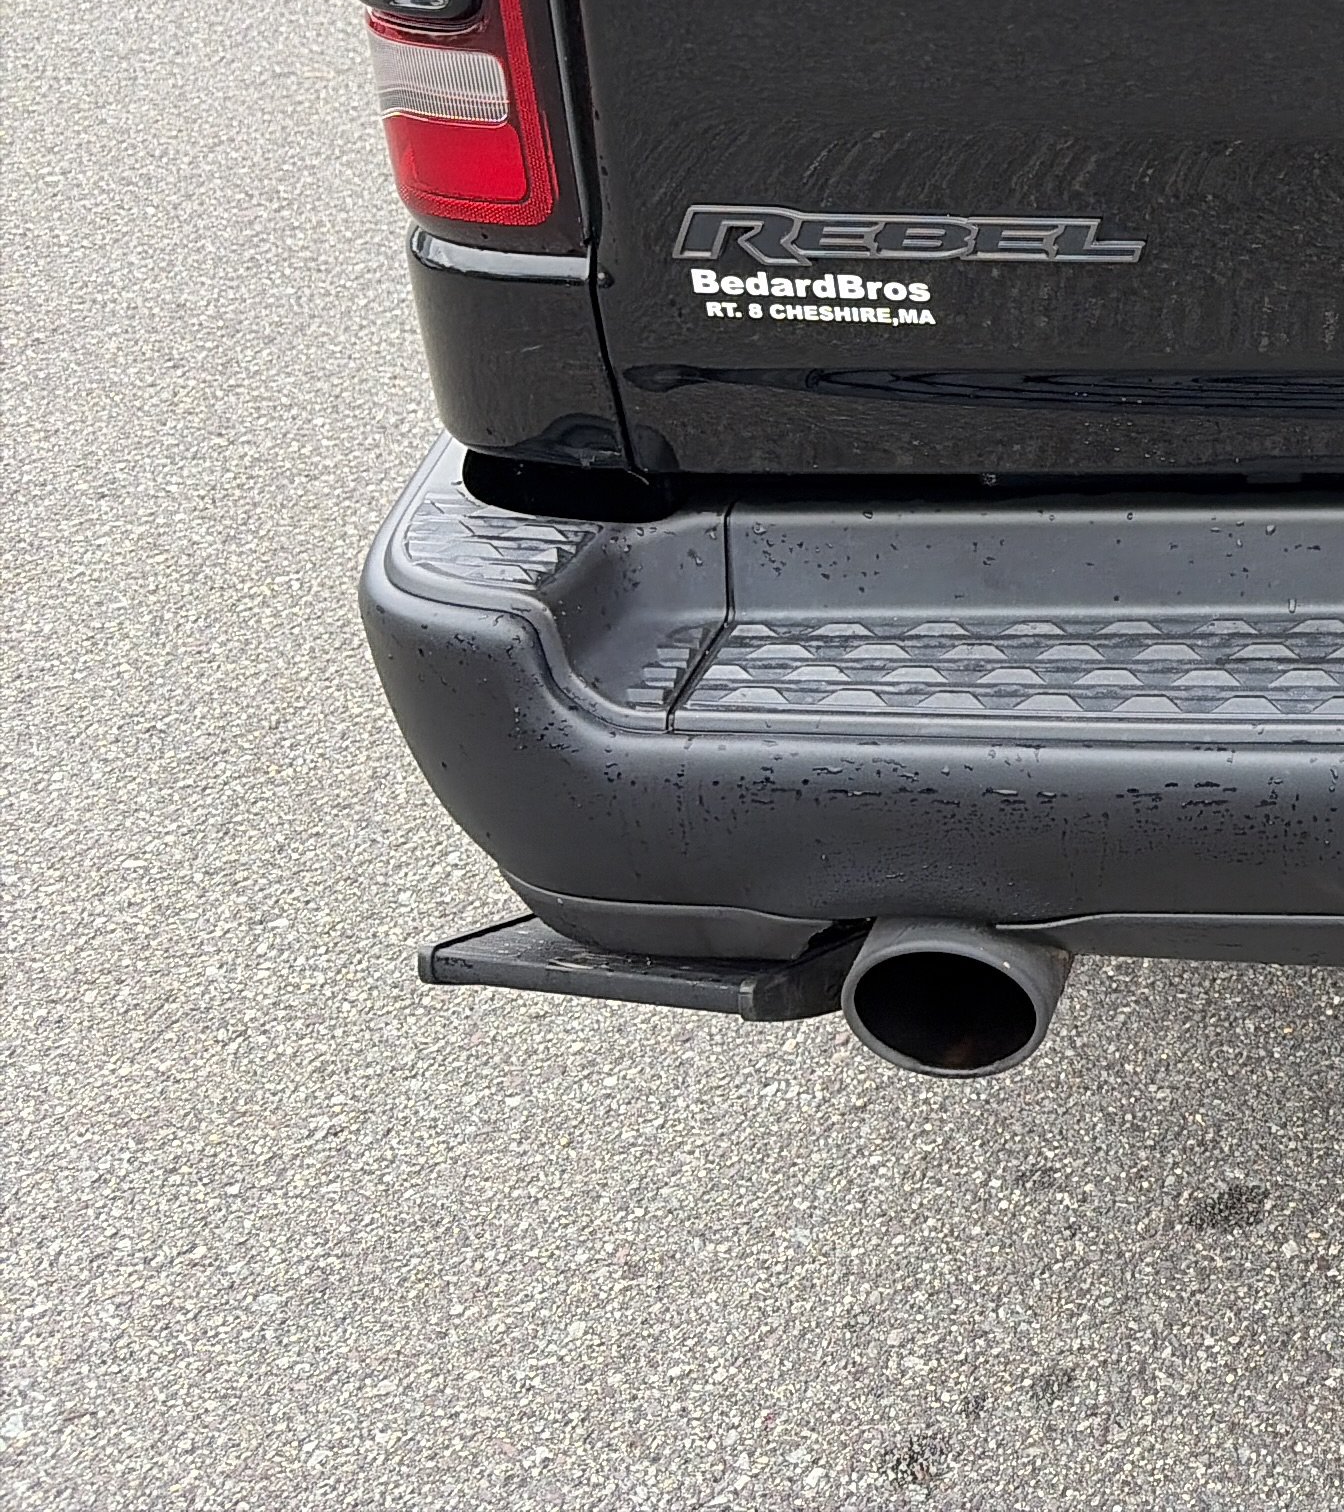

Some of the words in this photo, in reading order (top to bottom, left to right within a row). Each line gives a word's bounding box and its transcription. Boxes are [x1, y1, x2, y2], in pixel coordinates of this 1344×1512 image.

[672, 204, 1146, 266] REBEL
[690, 268, 931, 302] BedardBros
[705, 301, 743, 318] RT.
[748, 303, 763, 319] 8
